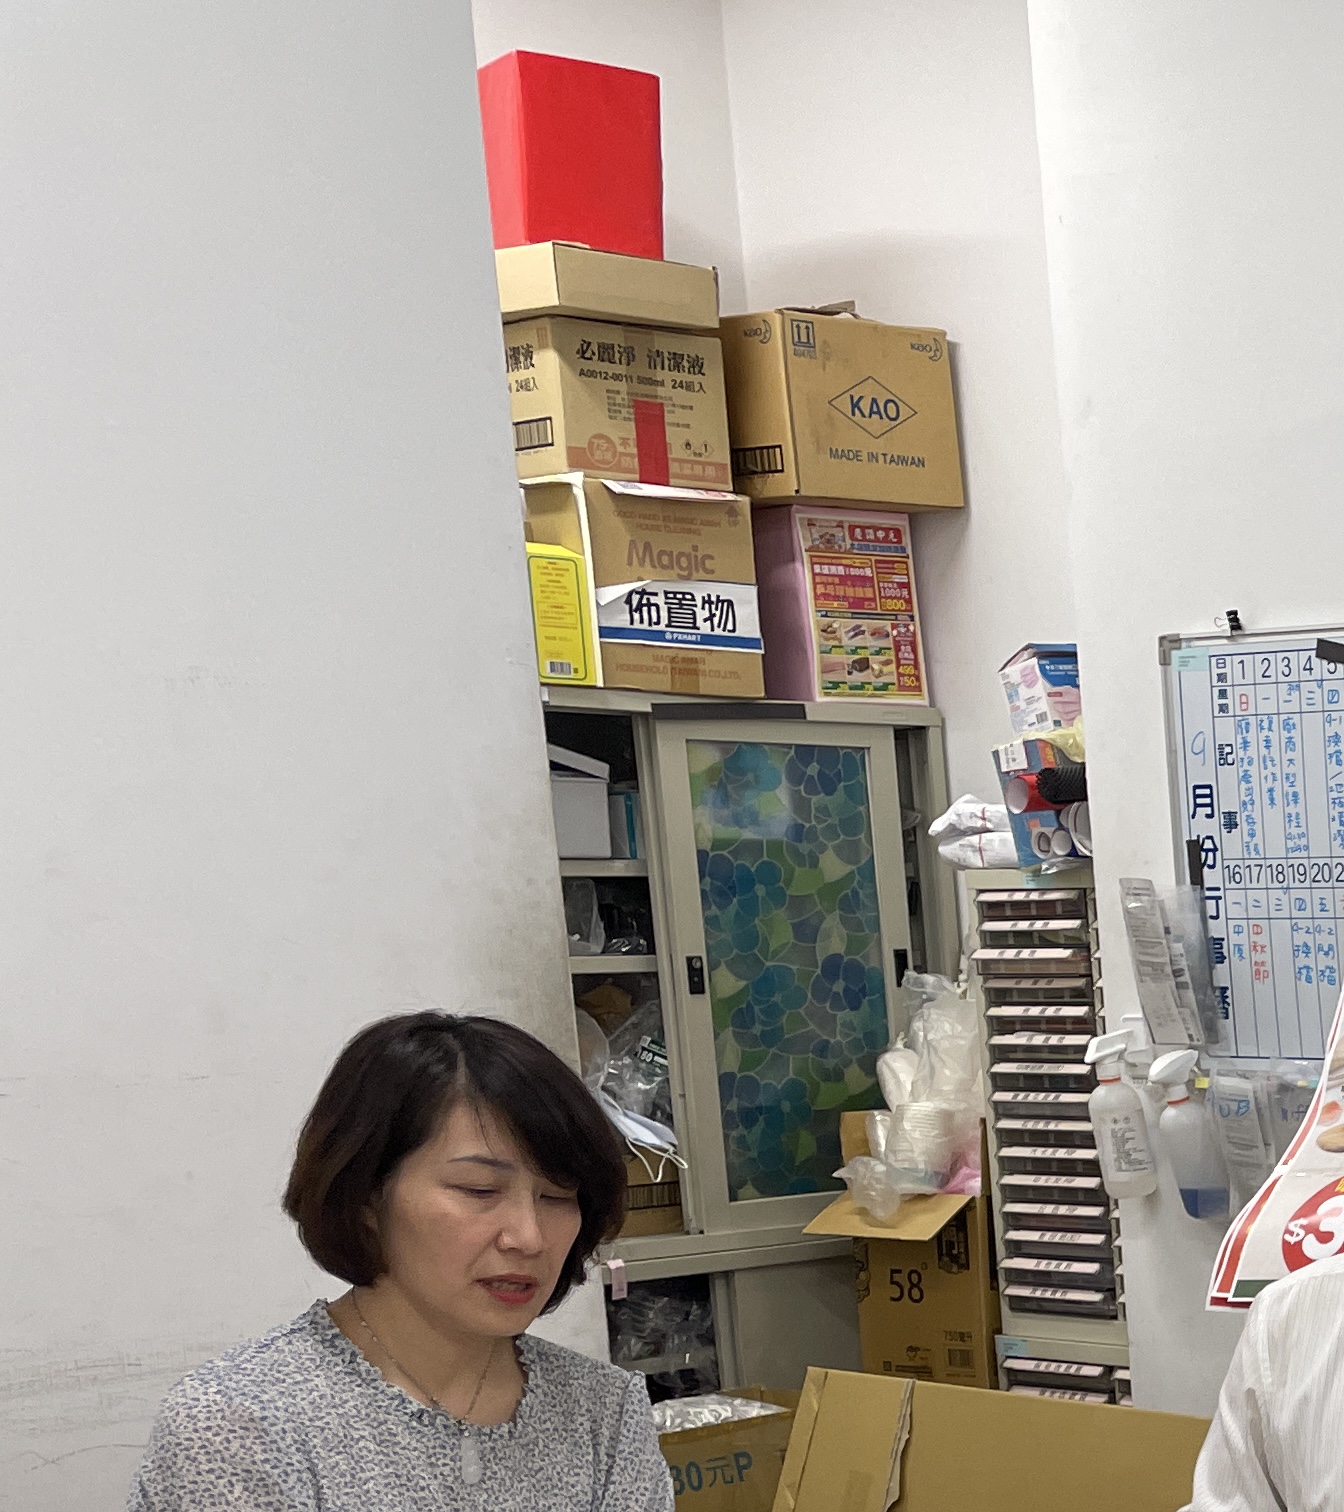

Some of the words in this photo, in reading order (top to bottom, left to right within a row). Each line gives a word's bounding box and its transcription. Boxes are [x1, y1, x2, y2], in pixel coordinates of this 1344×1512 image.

[507, 343, 536, 373] 潔液
[646, 348, 706, 376] 清潔液
[849, 394, 900, 422] KAO
[829, 447, 863, 462] MADE
[867, 452, 880, 463] IN
[881, 453, 926, 468] TAIWAN
[626, 540, 715, 580] Magic
[624, 588, 737, 633] 佈置物
[1216, 658, 1228, 684] 日期
[1238, 659, 1246, 680] 1
[1261, 658, 1272, 679] 2
[1281, 656, 1292, 677] 3
[1302, 655, 1314, 676] 4
[1224, 864, 1243, 885] 16
[1245, 863, 1264, 884] 17
[1267, 863, 1286, 884] 18
[1288, 863, 1307, 884] 19
[1311, 862, 1332, 883] 20
